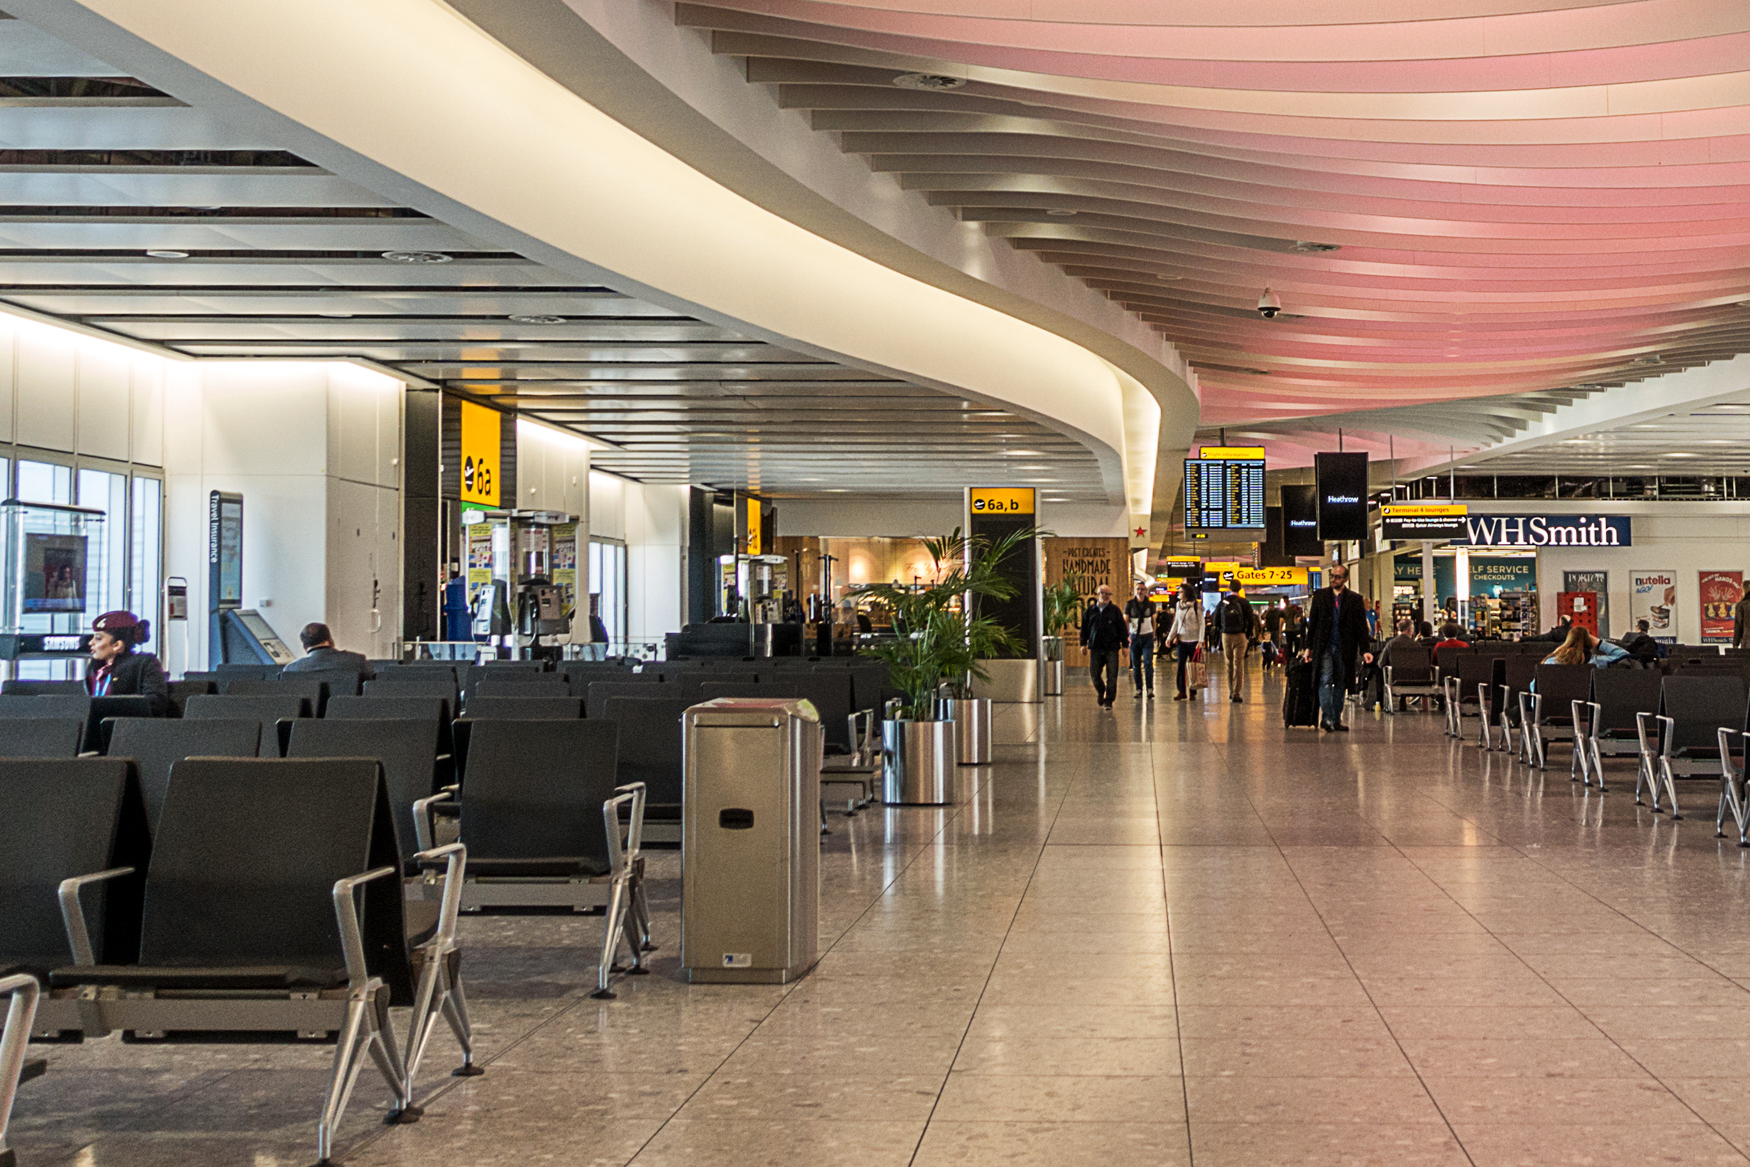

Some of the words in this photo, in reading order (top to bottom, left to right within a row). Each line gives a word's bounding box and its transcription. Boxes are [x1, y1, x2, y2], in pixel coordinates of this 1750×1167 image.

[477, 458, 492, 496] 6a
[1010, 499, 1019, 510] b
[1327, 495, 1359, 503] Heathrow
[210, 495, 220, 521] Travel
[1467, 516, 1620, 546] WHSmith
[210, 522, 220, 563] Insurance
[1067, 547, 1082, 558] PRET
[1082, 547, 1106, 558] CREATES
[1062, 558, 1112, 574] HANDMADE
[1486, 565, 1529, 574] SERVICE
[1236, 570, 1266, 580] Gates
[1269, 570, 1293, 580] 7-25
[1635, 575, 1671, 586] nutella
[43, 635, 81, 651] SAMSUNG
